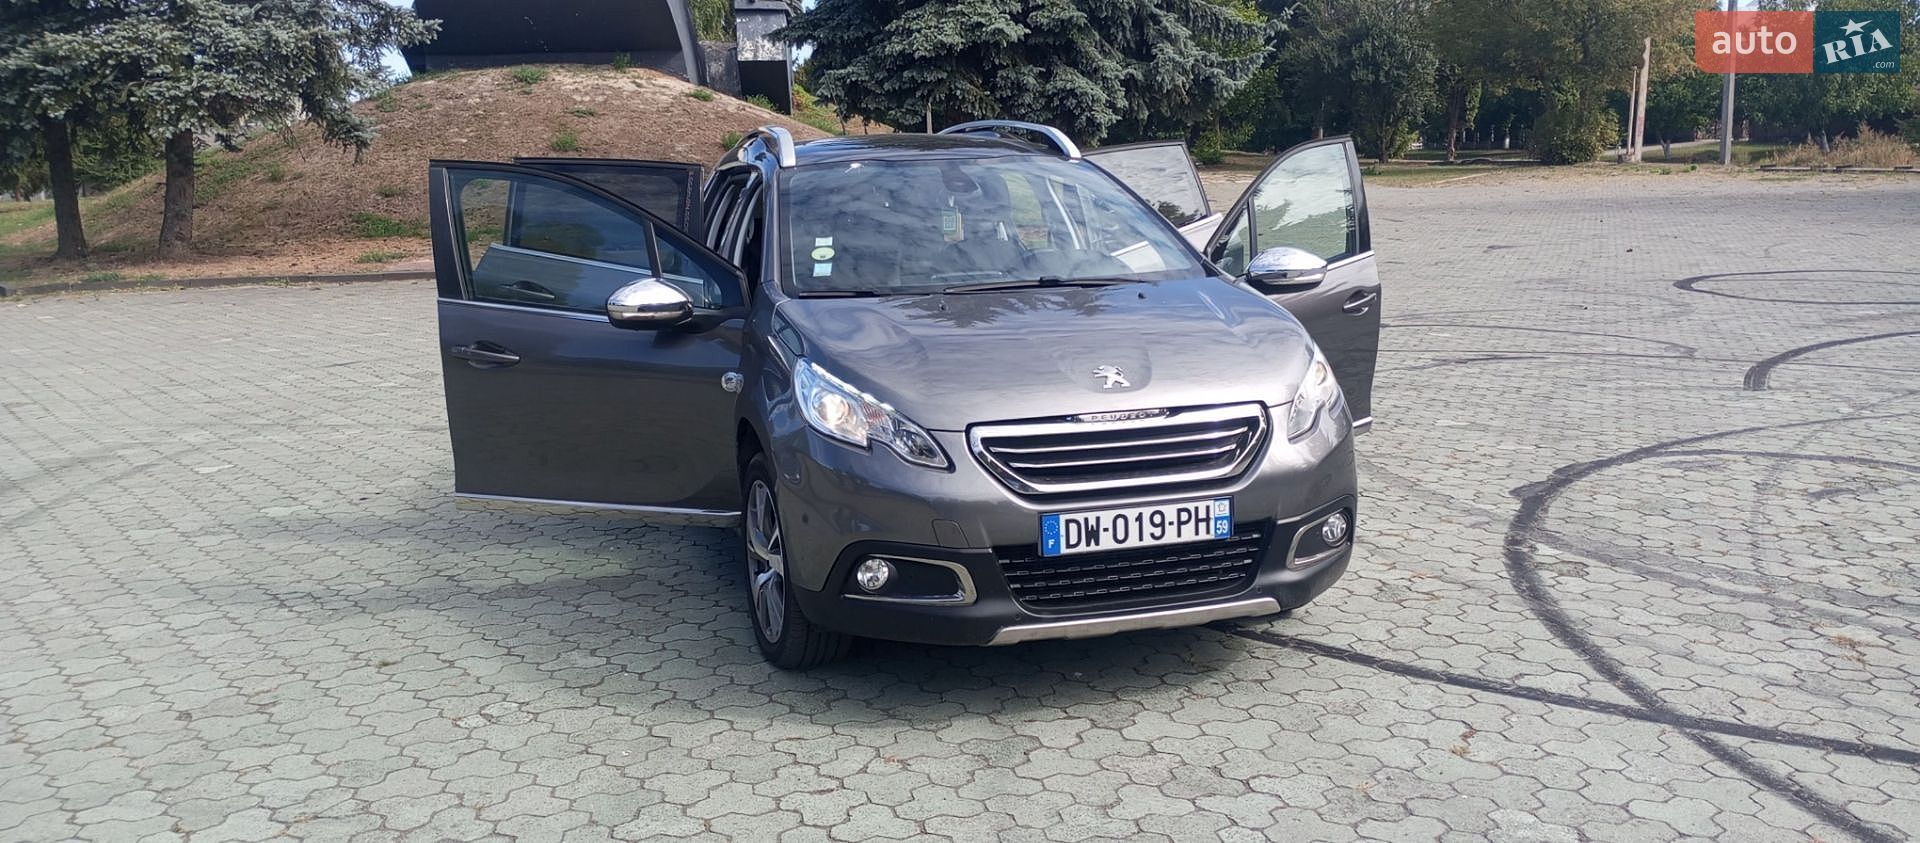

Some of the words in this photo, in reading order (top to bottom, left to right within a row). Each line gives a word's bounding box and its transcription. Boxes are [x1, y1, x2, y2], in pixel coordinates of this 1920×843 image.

[1048, 539, 1055, 549] F
[1064, 504, 1211, 550] DW-019-PH
[1216, 519, 1228, 534] 59
